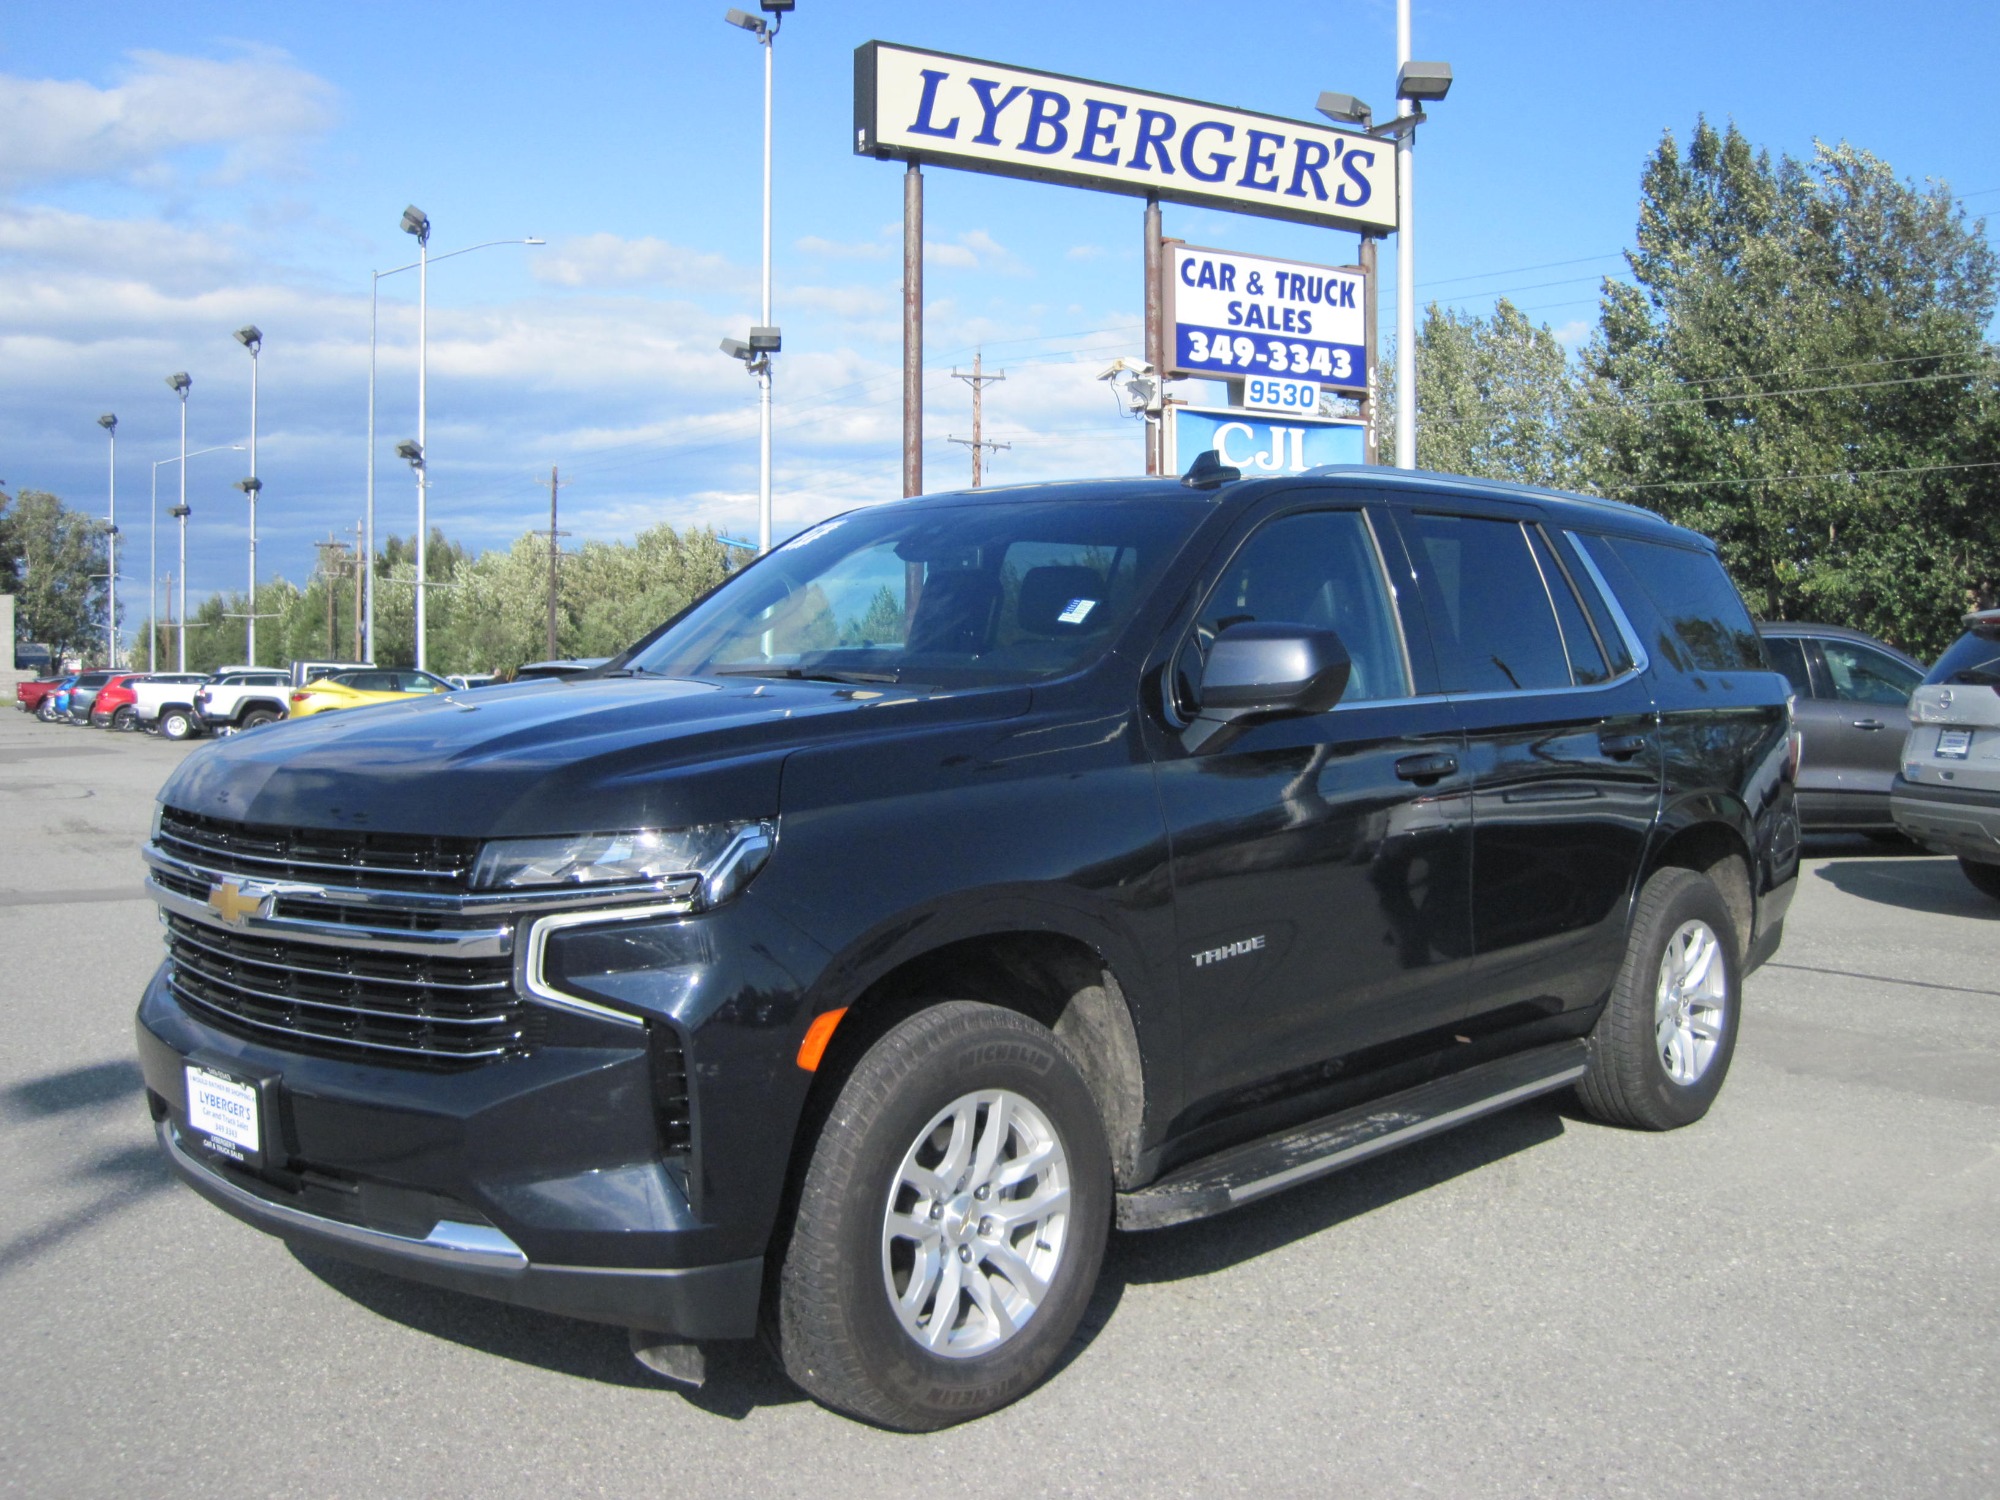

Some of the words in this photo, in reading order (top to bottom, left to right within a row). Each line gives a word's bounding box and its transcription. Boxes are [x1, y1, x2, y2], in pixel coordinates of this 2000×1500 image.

[907, 69, 1375, 208] LYBERGER'S
[1181, 258, 1236, 292] CAR
[1246, 271, 1265, 296] &
[1275, 271, 1356, 309] TRUCK
[1227, 300, 1312, 335] SALES
[1188, 331, 1352, 379] 349-3343
[1250, 380, 1315, 408] 9530
[1191, 935, 1266, 967] TAHOE
[199, 1090, 251, 1120] LYBERGER'S
